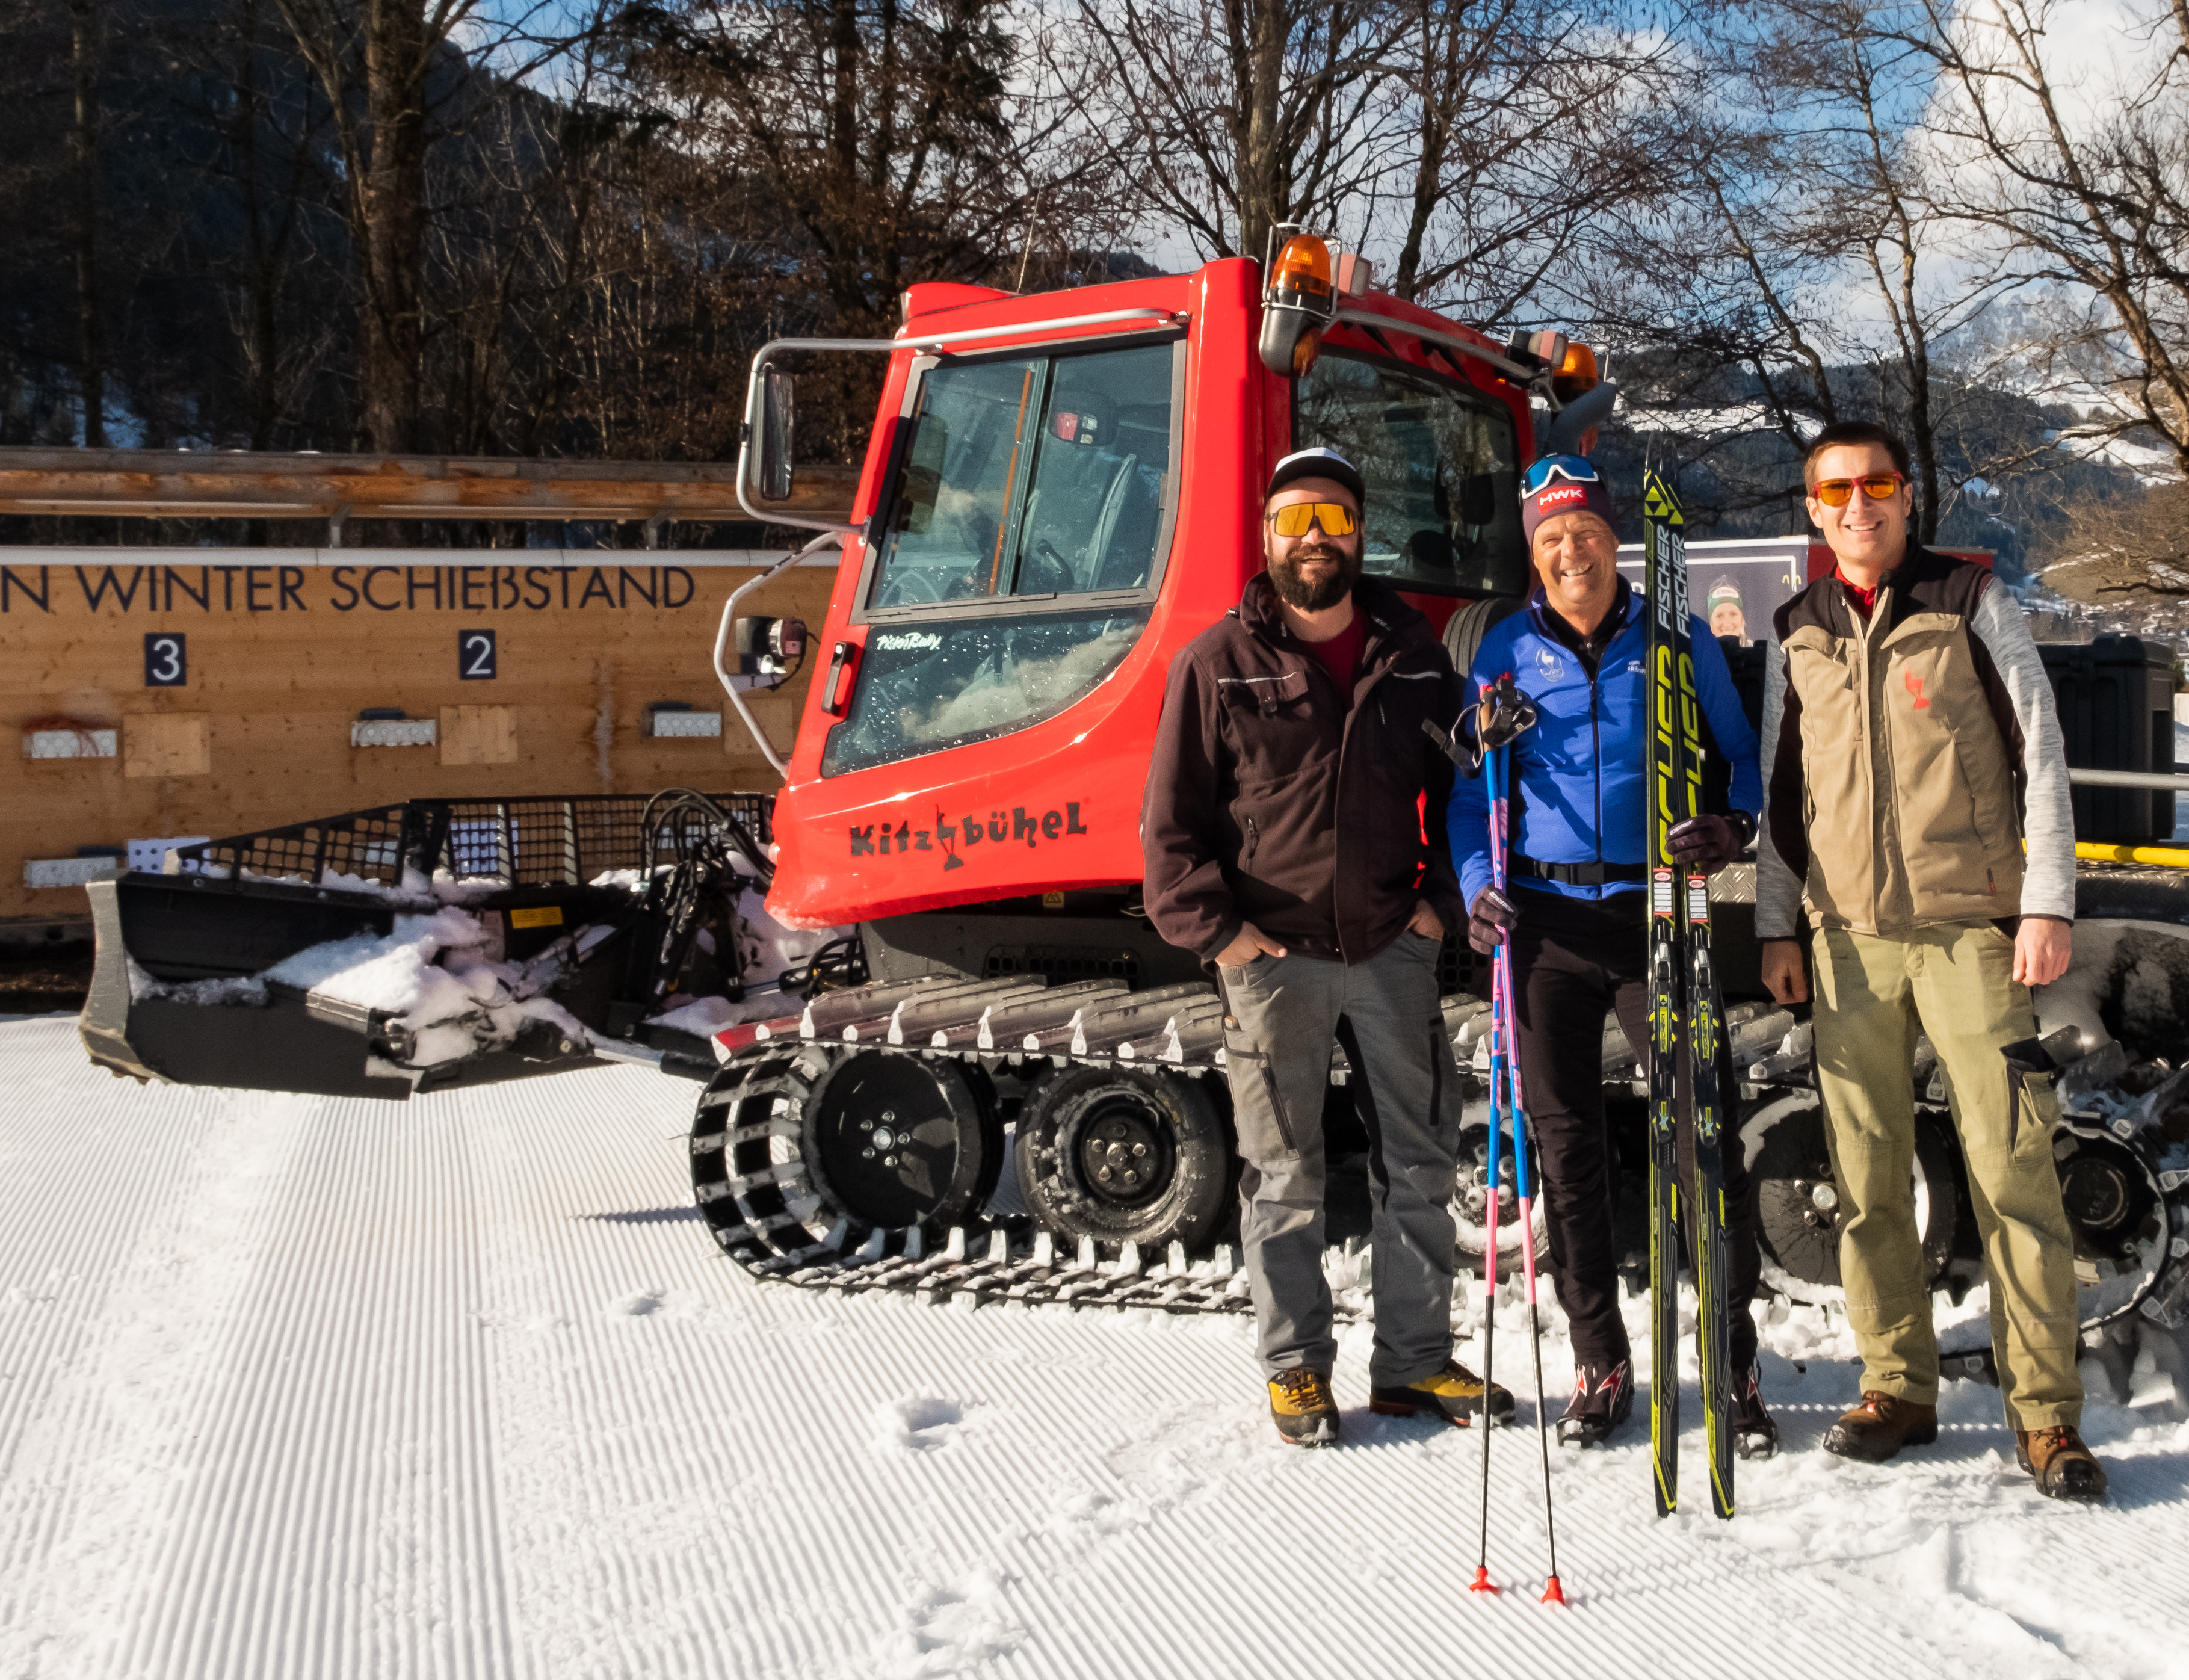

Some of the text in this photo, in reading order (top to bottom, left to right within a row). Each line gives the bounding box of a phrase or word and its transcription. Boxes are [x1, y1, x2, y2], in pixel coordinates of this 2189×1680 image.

[1539, 489, 1583, 506] HWK
[73, 565, 308, 613] WINTER
[330, 565, 695, 611] SCHIEßSTAND
[1657, 524, 1671, 630] FISCHER
[1672, 533, 1691, 638] FISCHER
[152, 639, 181, 681] 3
[466, 635, 492, 676] 2
